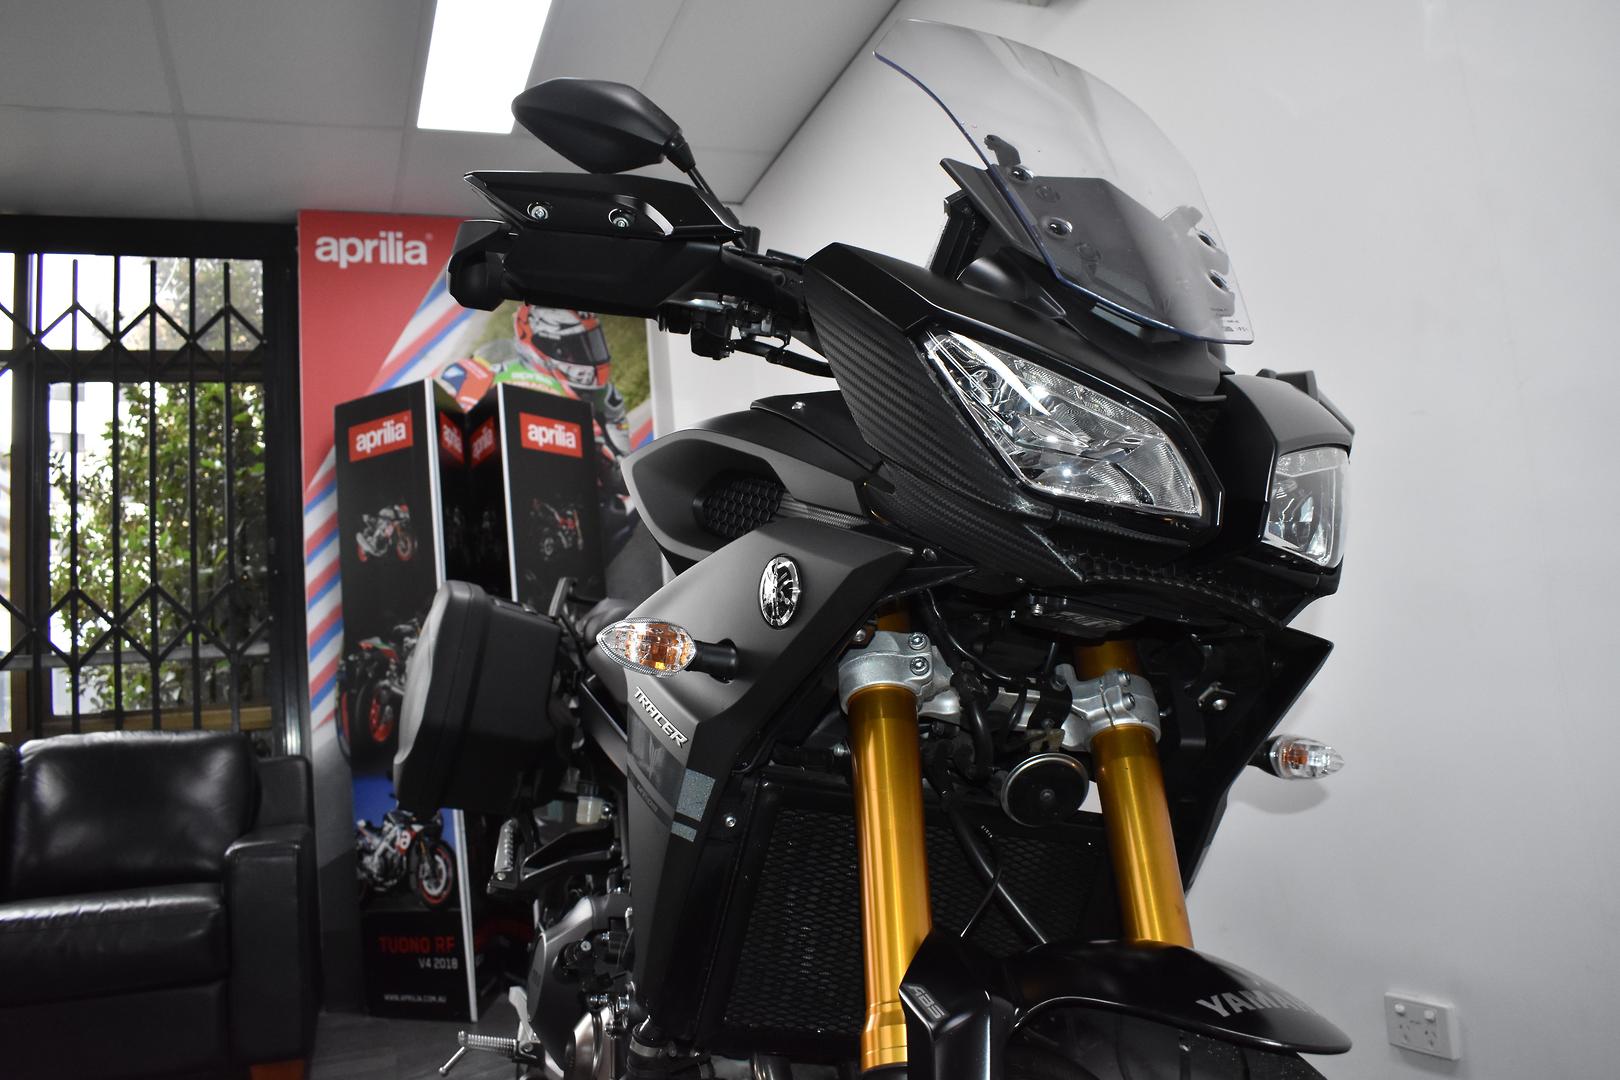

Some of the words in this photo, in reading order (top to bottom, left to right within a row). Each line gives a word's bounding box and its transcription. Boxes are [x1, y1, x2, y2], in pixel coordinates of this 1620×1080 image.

[315, 231, 428, 268] aprilia
[356, 419, 407, 453] aprilia
[527, 423, 577, 448] aprilia
[634, 686, 688, 748] TRACER
[378, 936, 430, 954] TUONO
[434, 936, 455, 954] RF
[417, 957, 431, 969] V4
[433, 957, 458, 970] 2018
[908, 985, 945, 1019] ABS
